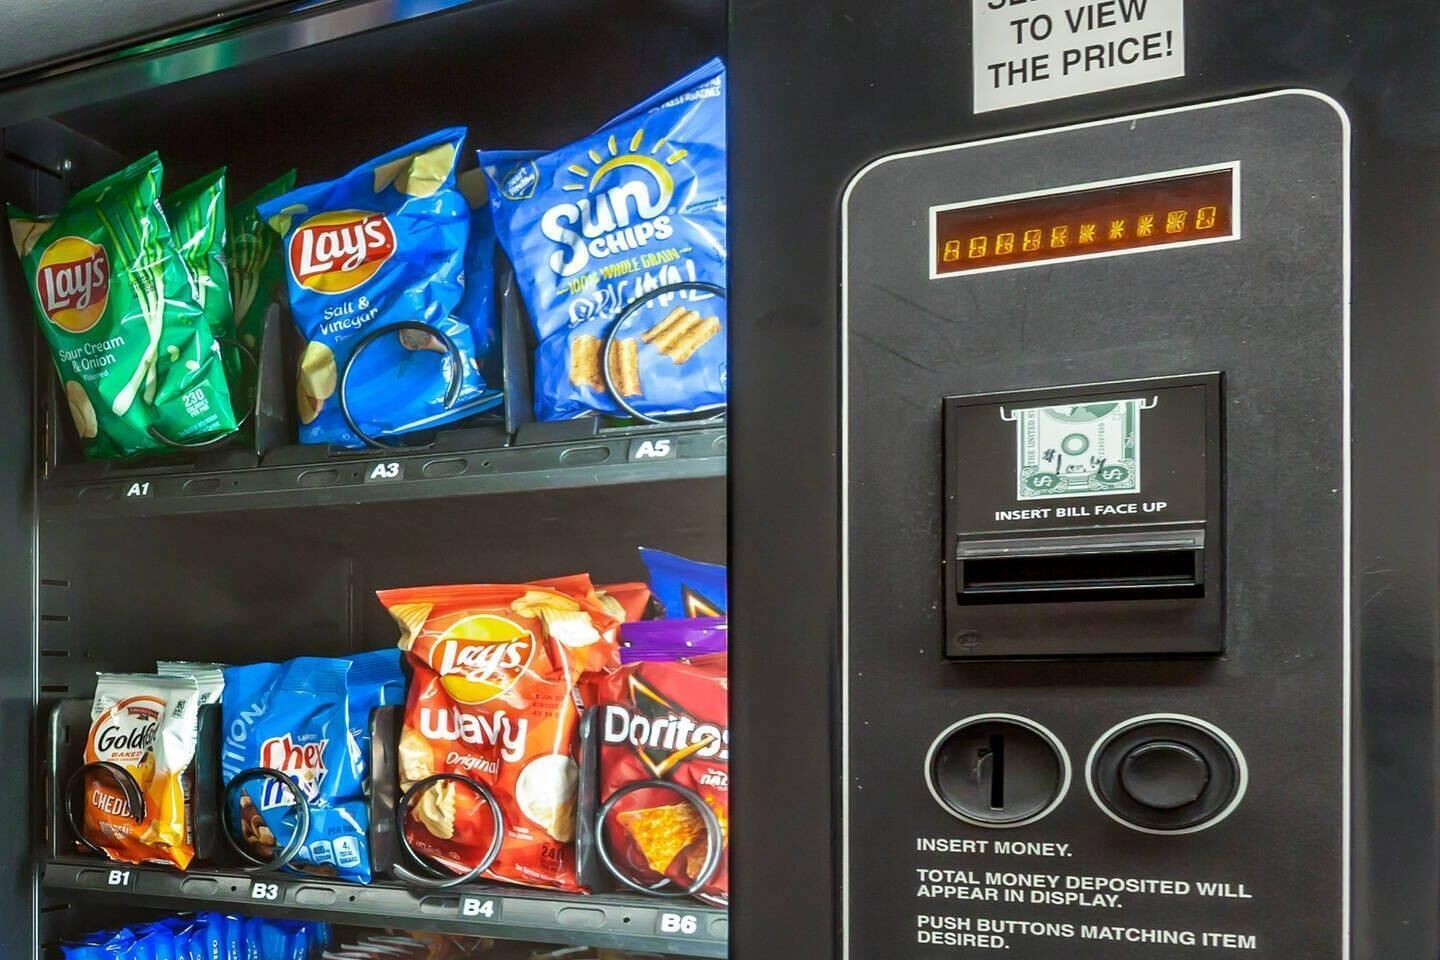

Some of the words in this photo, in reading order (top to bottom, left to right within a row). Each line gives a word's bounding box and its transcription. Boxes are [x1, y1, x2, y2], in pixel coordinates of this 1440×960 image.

[1010, 14, 1052, 44] TO
[1064, 0, 1148, 34] VIEW
[987, 54, 1050, 88] THE
[1062, 30, 1173, 76] PRICE!
[541, 180, 664, 277] Sun
[588, 214, 672, 258] CHIPS
[300, 216, 386, 275] Lay's
[600, 258, 640, 281] WHOLE
[642, 248, 680, 270] GRAIN
[43, 254, 106, 312] Lay's
[324, 301, 354, 320] Salt
[358, 296, 370, 310] &
[59, 347, 83, 363] Sour
[84, 335, 125, 356] Cream
[82, 353, 116, 371] Onion
[183, 388, 206, 408] 230
[636, 440, 670, 459] A5
[370, 462, 400, 480] A3
[127, 483, 150, 497] A1
[995, 508, 1052, 522] INSERT
[1056, 506, 1090, 518] BILL
[1094, 503, 1138, 516] FACE
[1142, 501, 1168, 513] UP
[440, 636, 530, 683] Lay's
[262, 736, 327, 772] Chex
[446, 750, 500, 776] Original
[916, 838, 989, 854] INSERT
[994, 841, 1072, 857] MONEY.
[108, 870, 130, 886] B1
[916, 868, 980, 885] TOTAL
[985, 872, 1061, 888] MONEY
[1065, 876, 1190, 895] DEPOSITED
[1196, 882, 1253, 899] WILL
[252, 883, 279, 899] B3
[916, 884, 999, 902] APPEAR
[1004, 888, 1024, 903] IN
[1030, 890, 1122, 908] DISPLAY.
[463, 899, 494, 918] B4
[660, 914, 697, 934] B6
[917, 914, 971, 931] PUSH
[977, 918, 1075, 938] BUTTONS
[1081, 924, 1196, 946] MATCHING
[1202, 932, 1257, 950] ITEM
[917, 930, 1010, 949] DESIRED.
